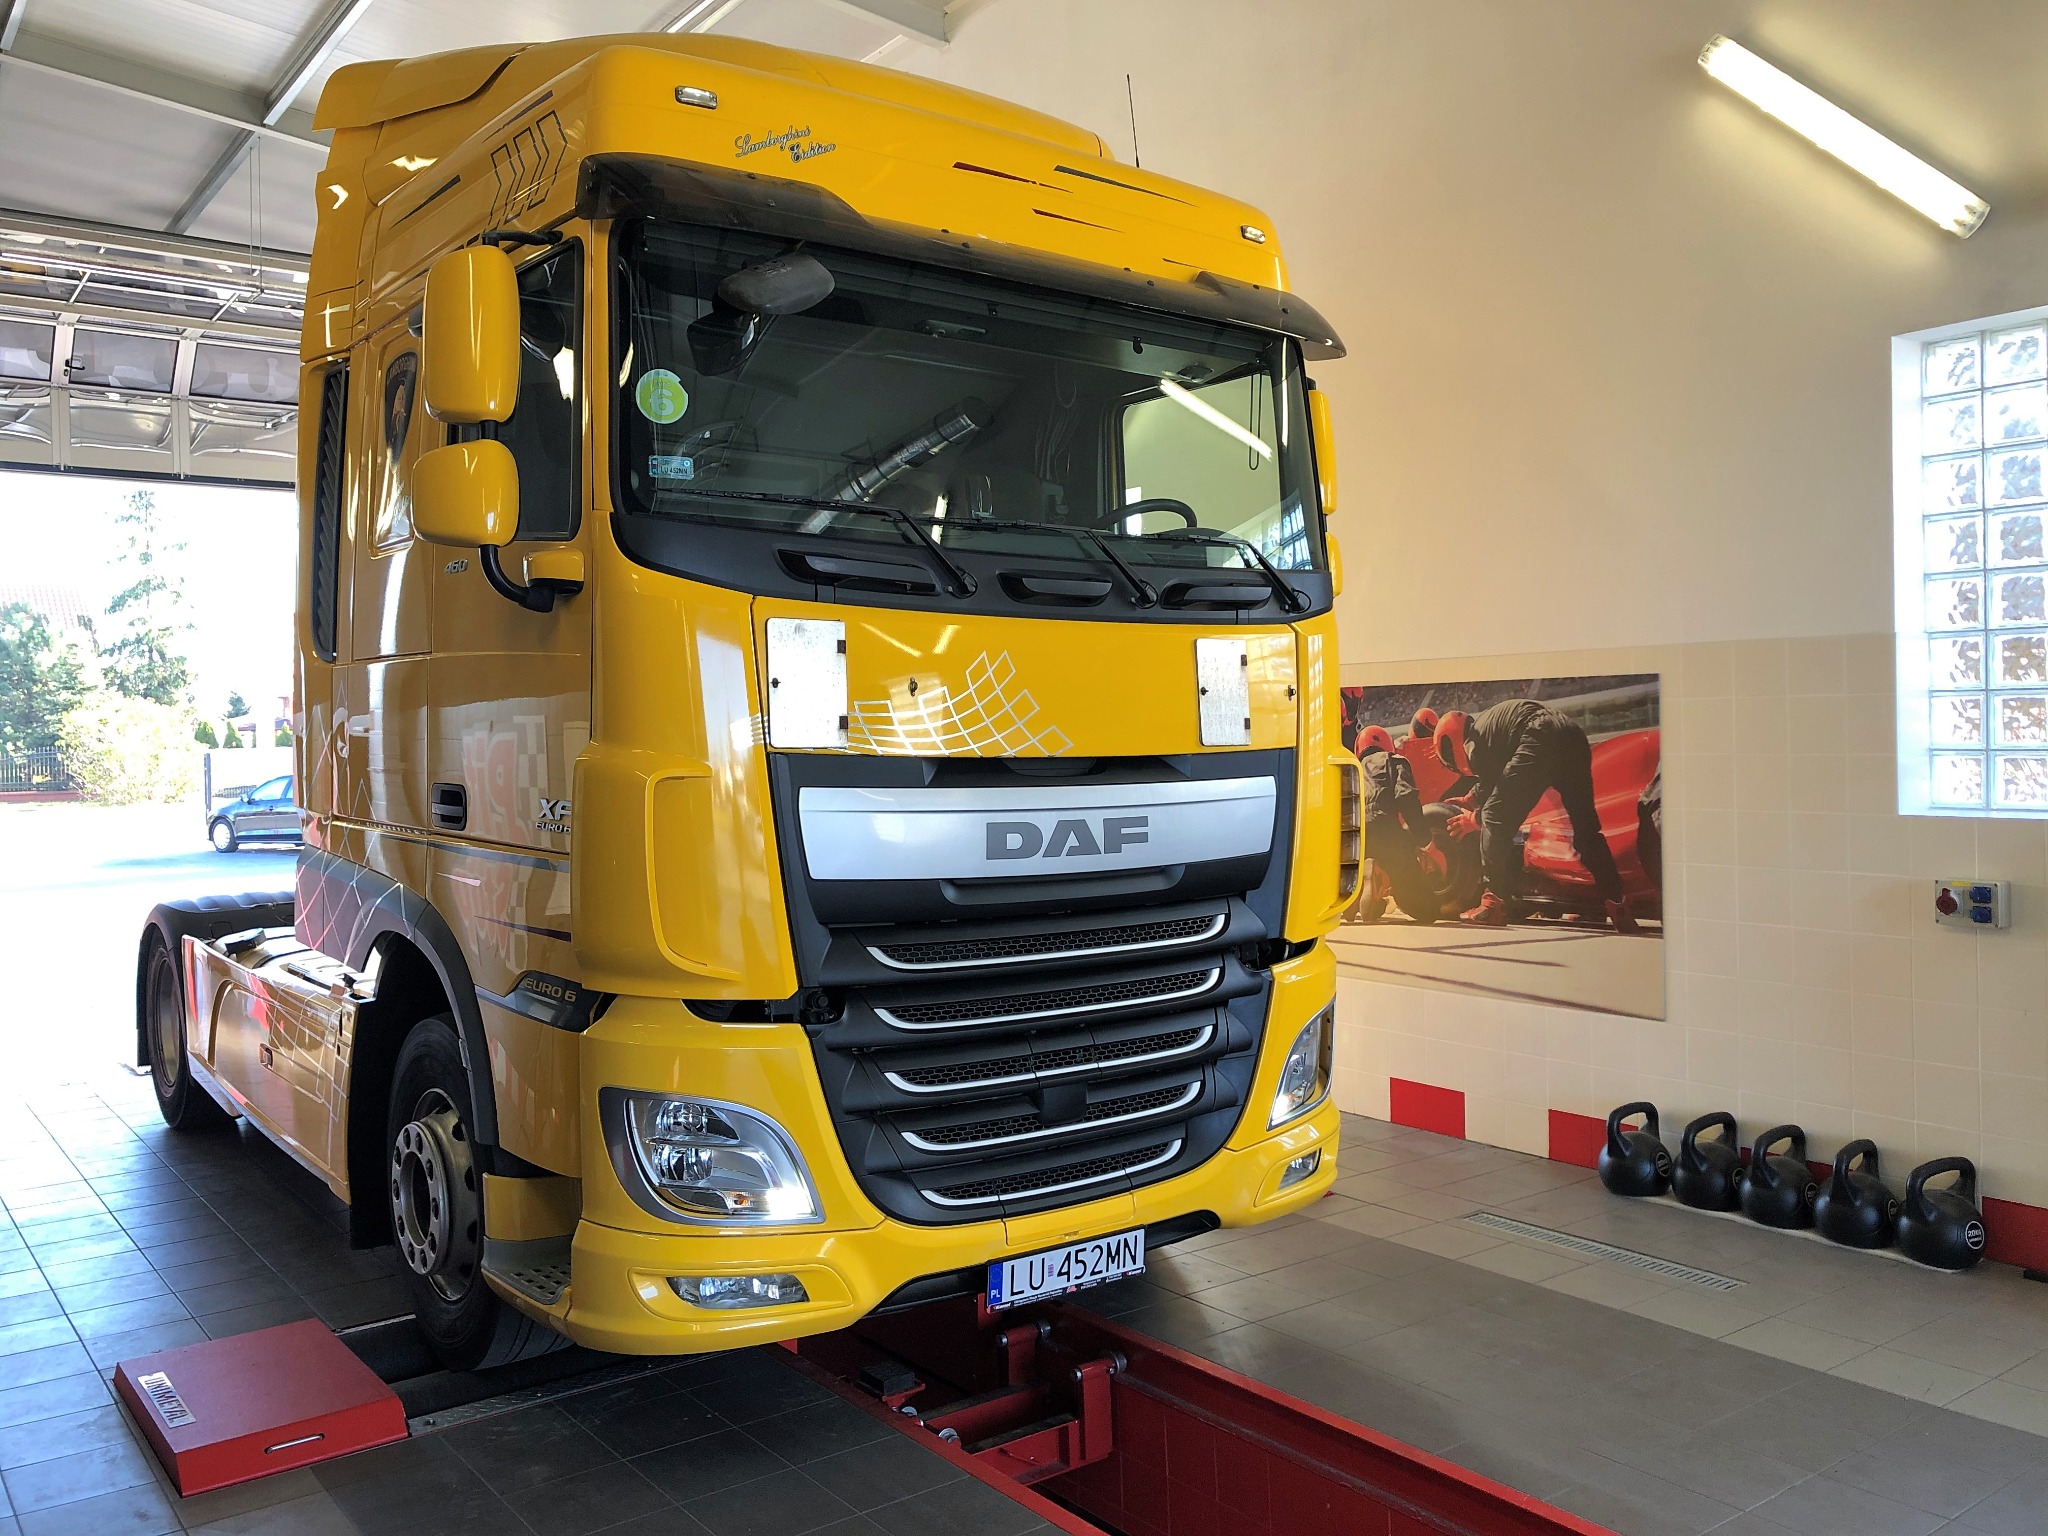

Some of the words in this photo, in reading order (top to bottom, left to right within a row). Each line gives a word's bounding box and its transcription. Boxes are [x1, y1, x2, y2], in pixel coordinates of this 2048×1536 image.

[735, 125, 811, 157] Lamborghini
[650, 388, 674, 416] 6
[444, 558, 468, 574] 460
[539, 798, 572, 820] XF
[535, 821, 563, 833] EURO
[986, 815, 1149, 860] DAF
[524, 978, 562, 998] EURO
[564, 990, 577, 1003] 6
[1010, 1257, 1046, 1297] LU
[1056, 1234, 1139, 1283] 452MN
[990, 1289, 1001, 1299] PL
[144, 1376, 188, 1424] UNIMETAL
